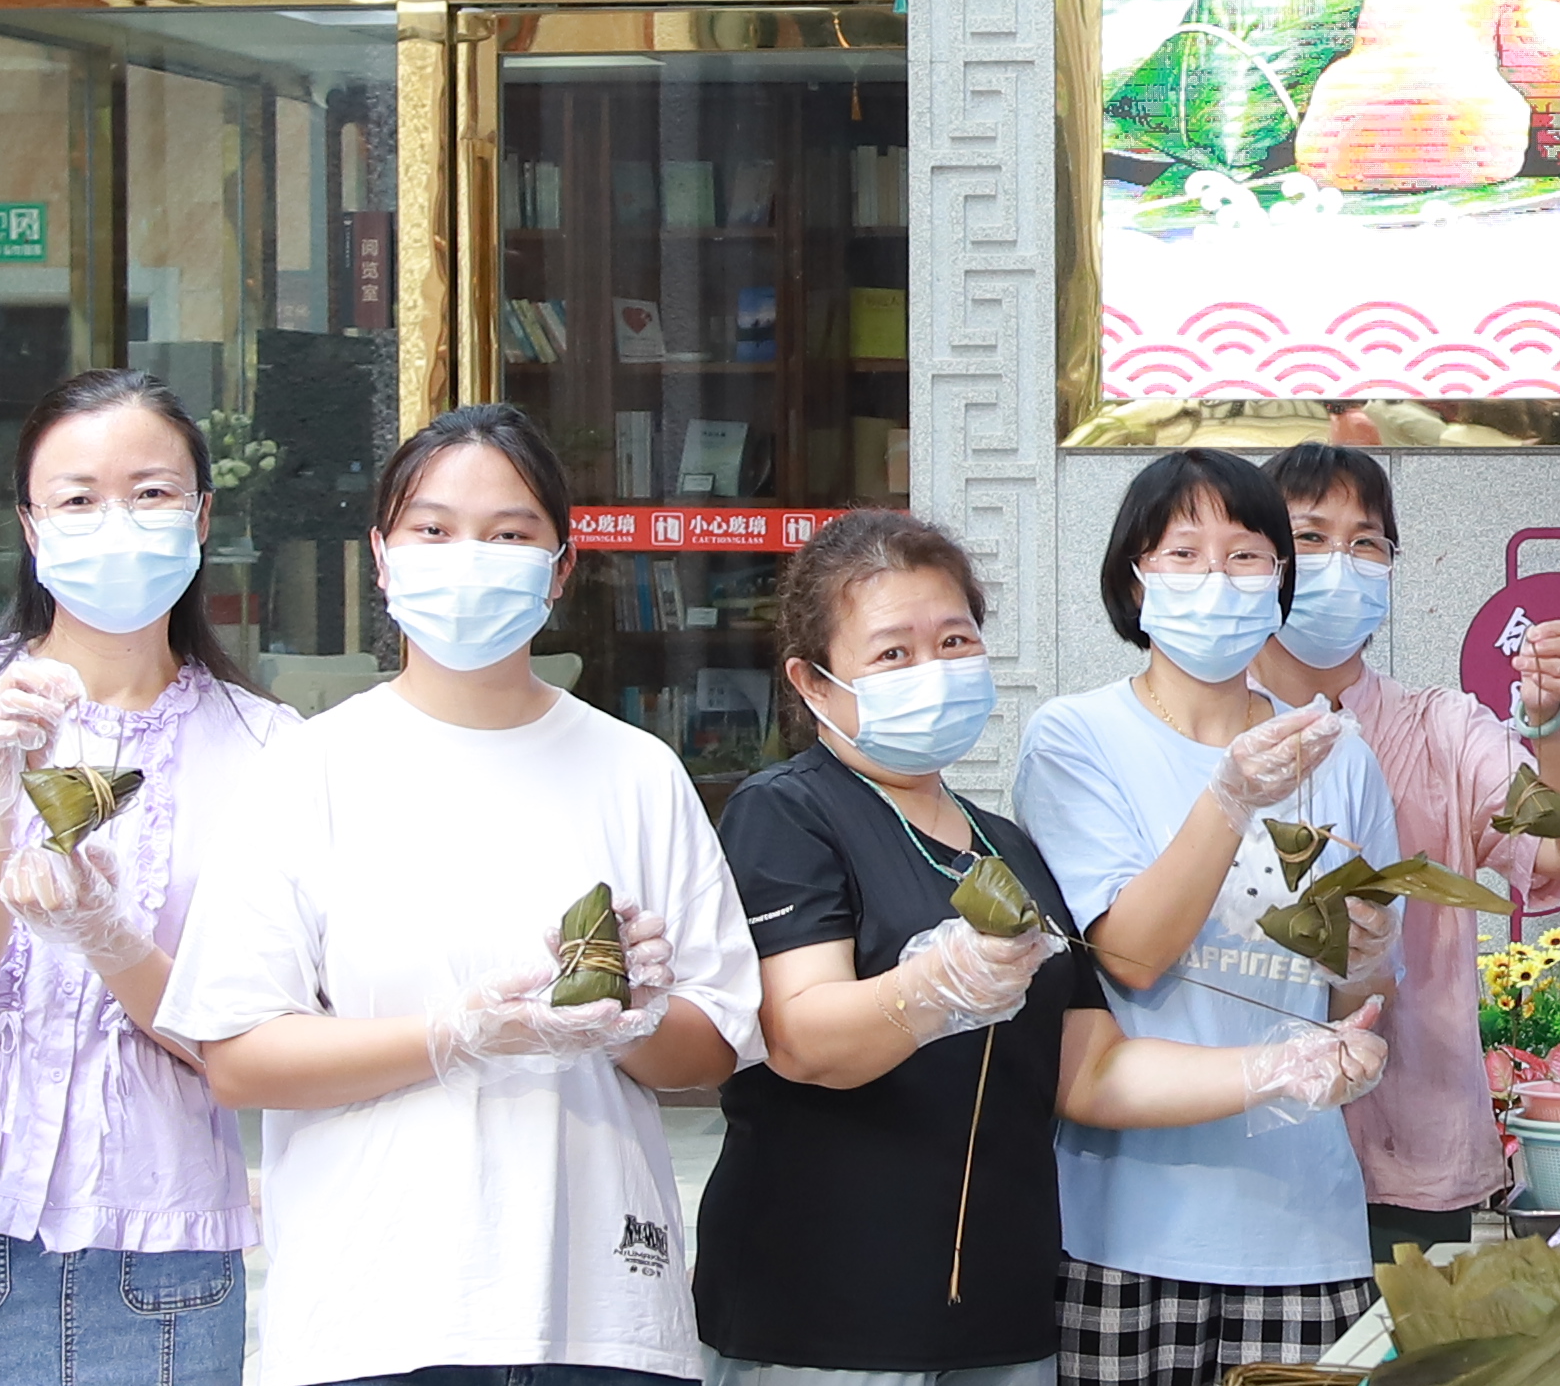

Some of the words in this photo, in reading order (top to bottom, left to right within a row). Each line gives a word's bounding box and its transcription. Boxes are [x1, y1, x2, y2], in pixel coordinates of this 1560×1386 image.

[360, 238, 379, 302] 阅览室
[689, 514, 767, 535] 小心玻璃
